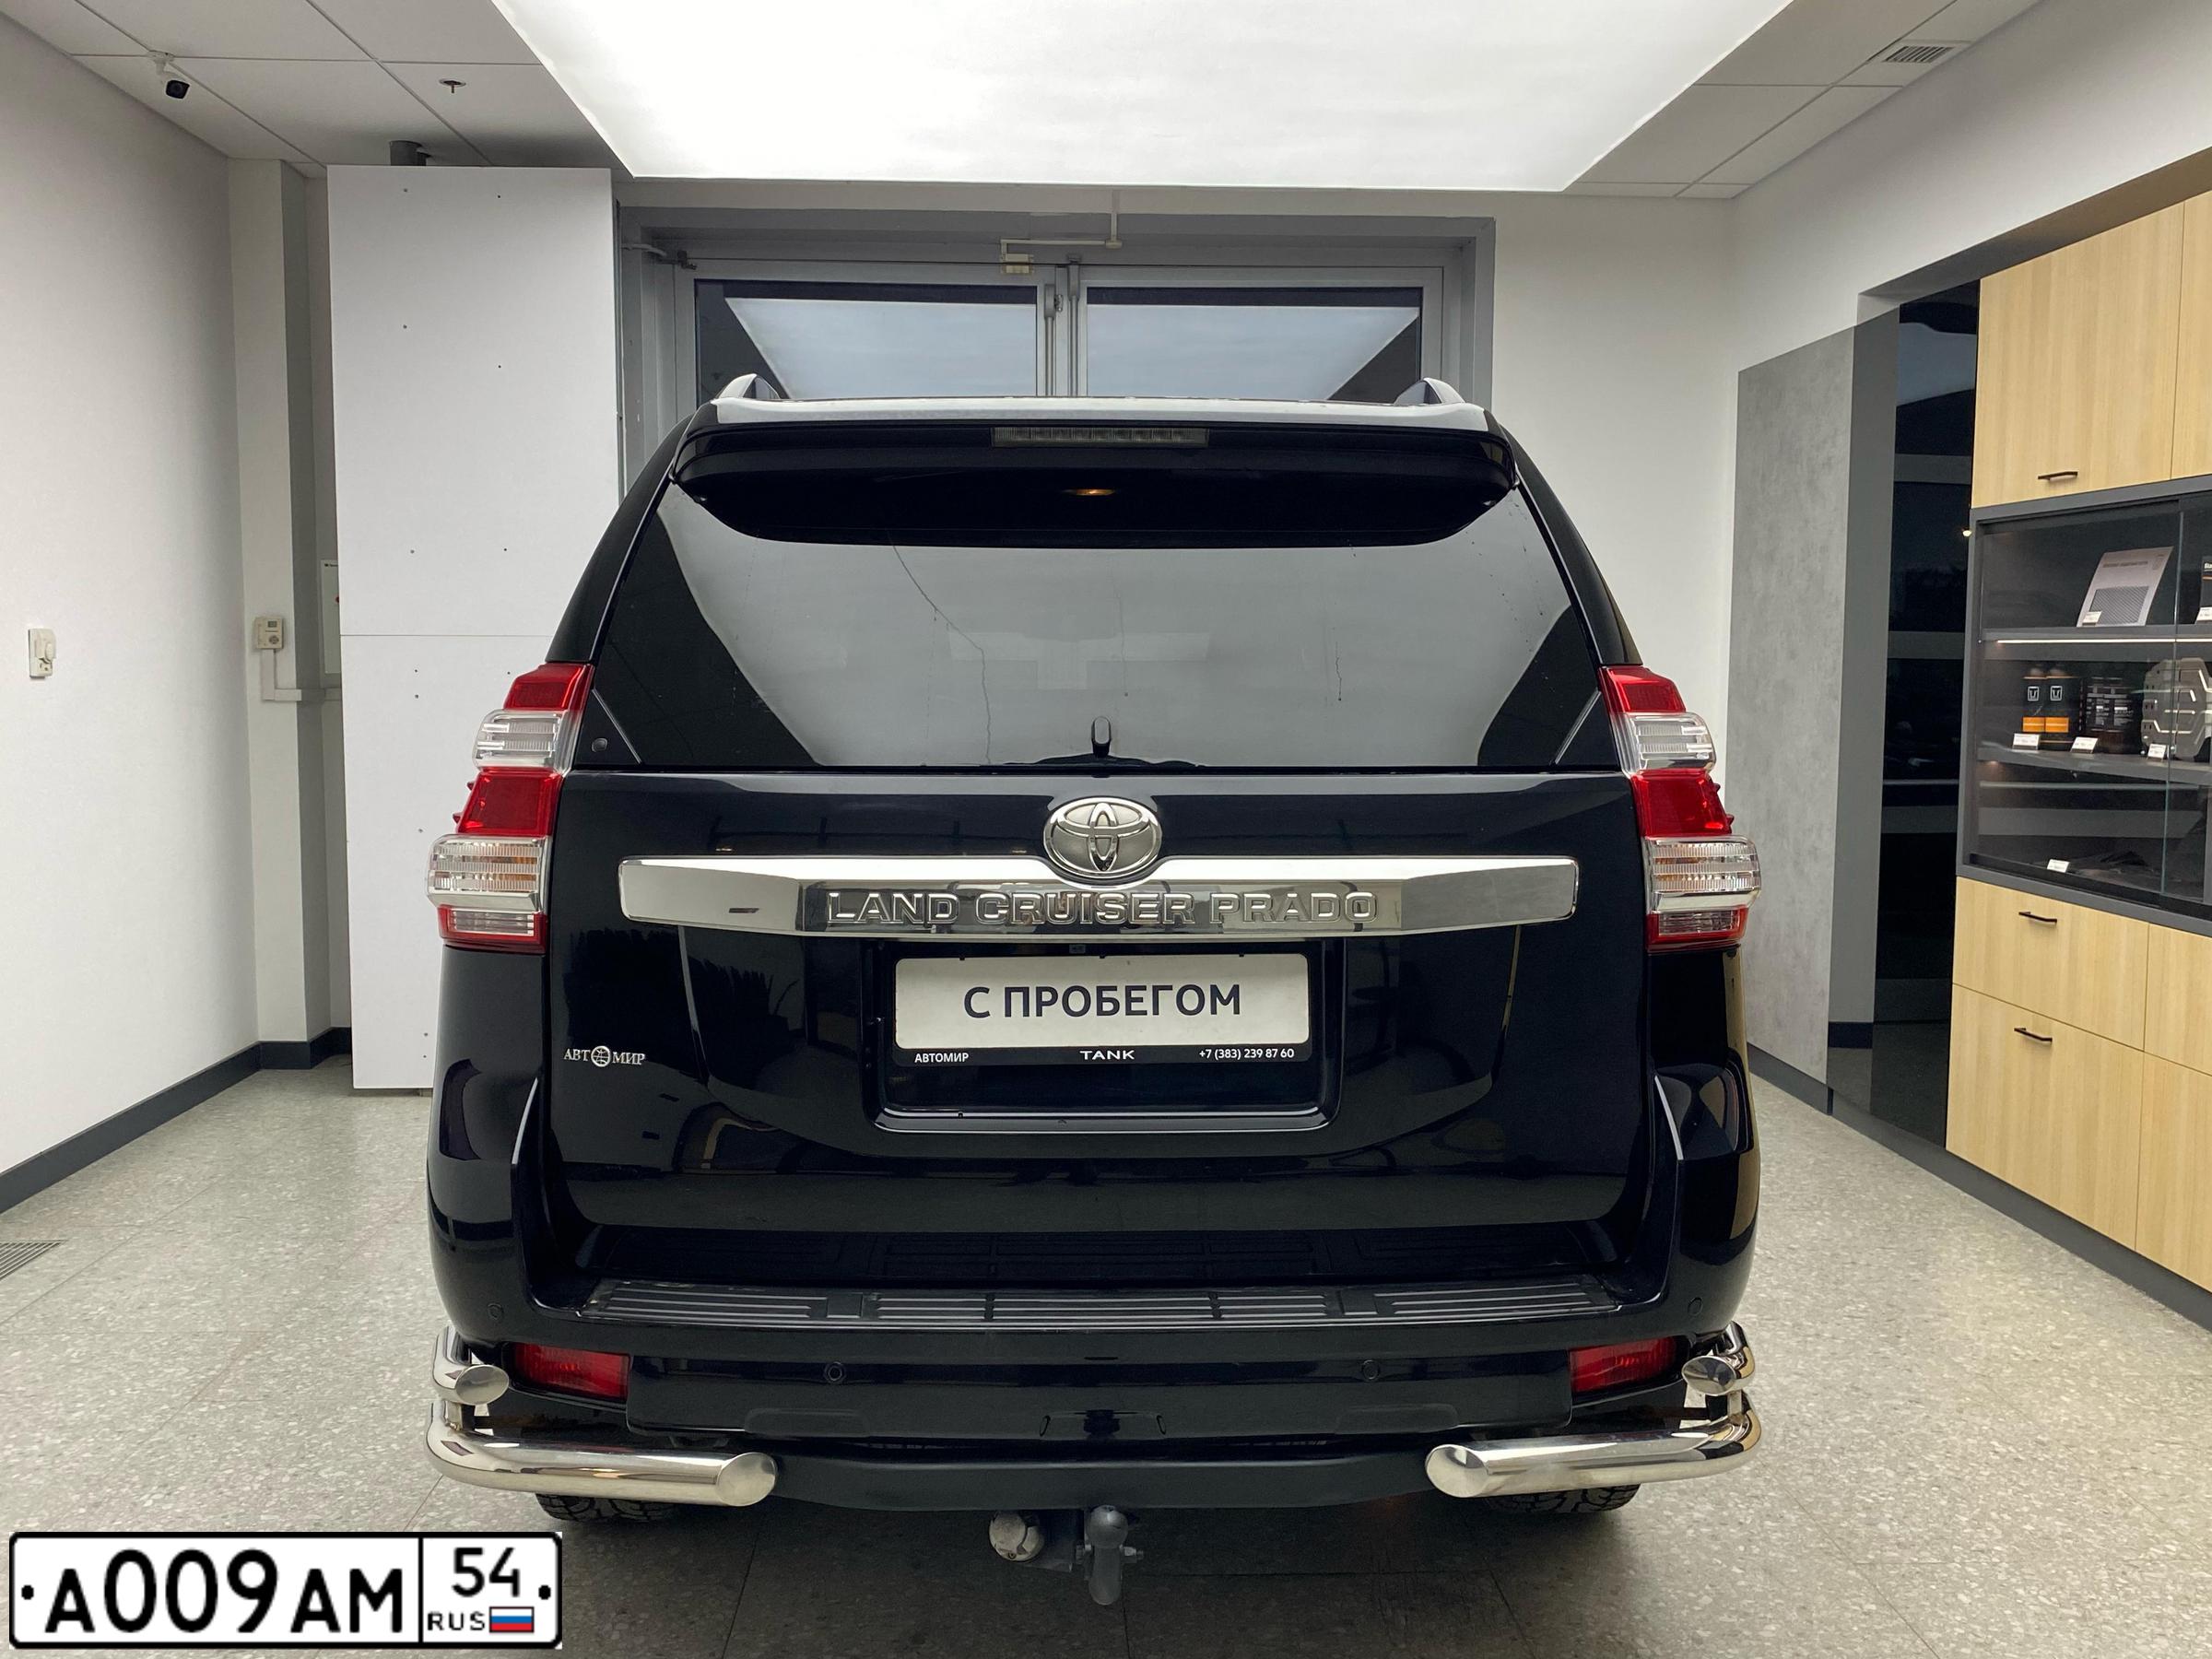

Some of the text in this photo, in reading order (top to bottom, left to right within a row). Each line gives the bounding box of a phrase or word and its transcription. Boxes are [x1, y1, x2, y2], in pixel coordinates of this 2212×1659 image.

[828, 891, 1379, 924] LAND CRUISER PRADO
[1004, 983, 1241, 1018] ПРОБЕГОМ
[914, 1053, 969, 1064] АВТОМИР
[1079, 1050, 1135, 1061] TANK
[1199, 1048, 1295, 1061] +7 (383) 239 87 60
